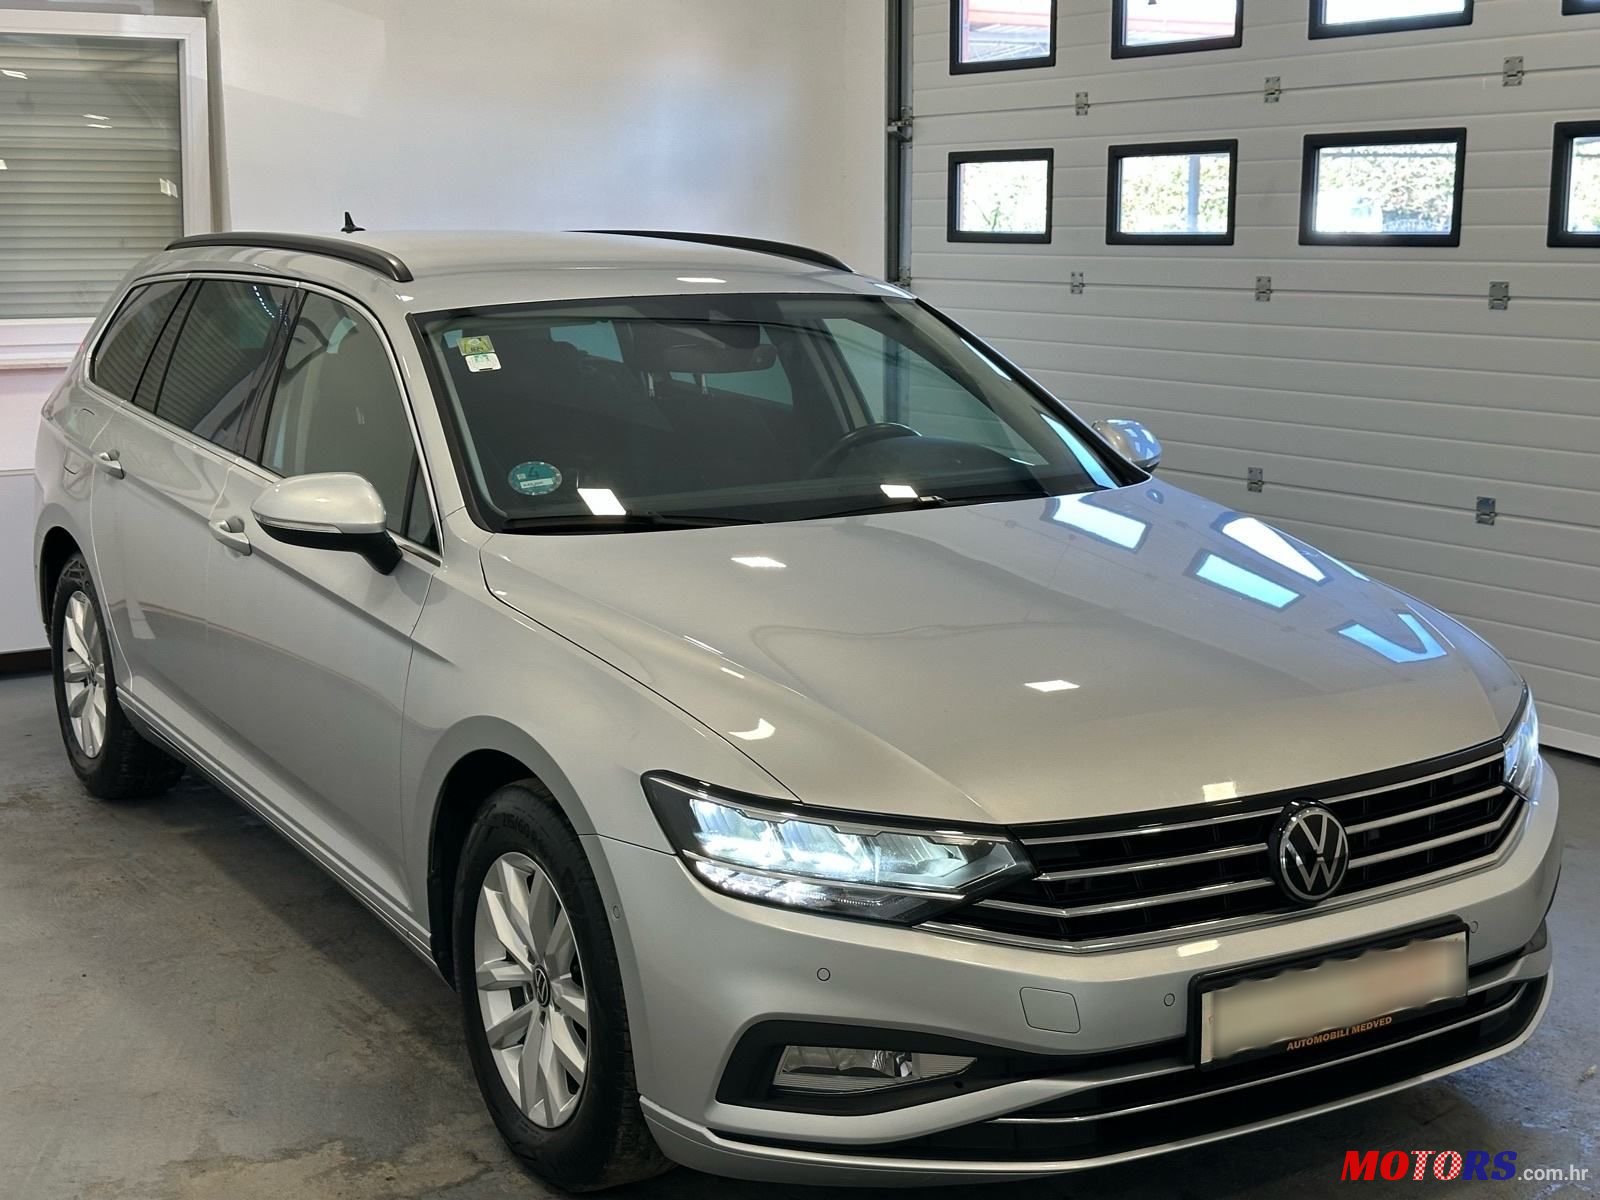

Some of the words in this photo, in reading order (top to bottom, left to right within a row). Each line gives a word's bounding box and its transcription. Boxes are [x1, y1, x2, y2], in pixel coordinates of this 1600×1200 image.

[1283, 811, 1346, 895] VW
[1286, 1028, 1350, 1051] AUTOMOBILI
[1351, 1016, 1393, 1034] MEDVED
